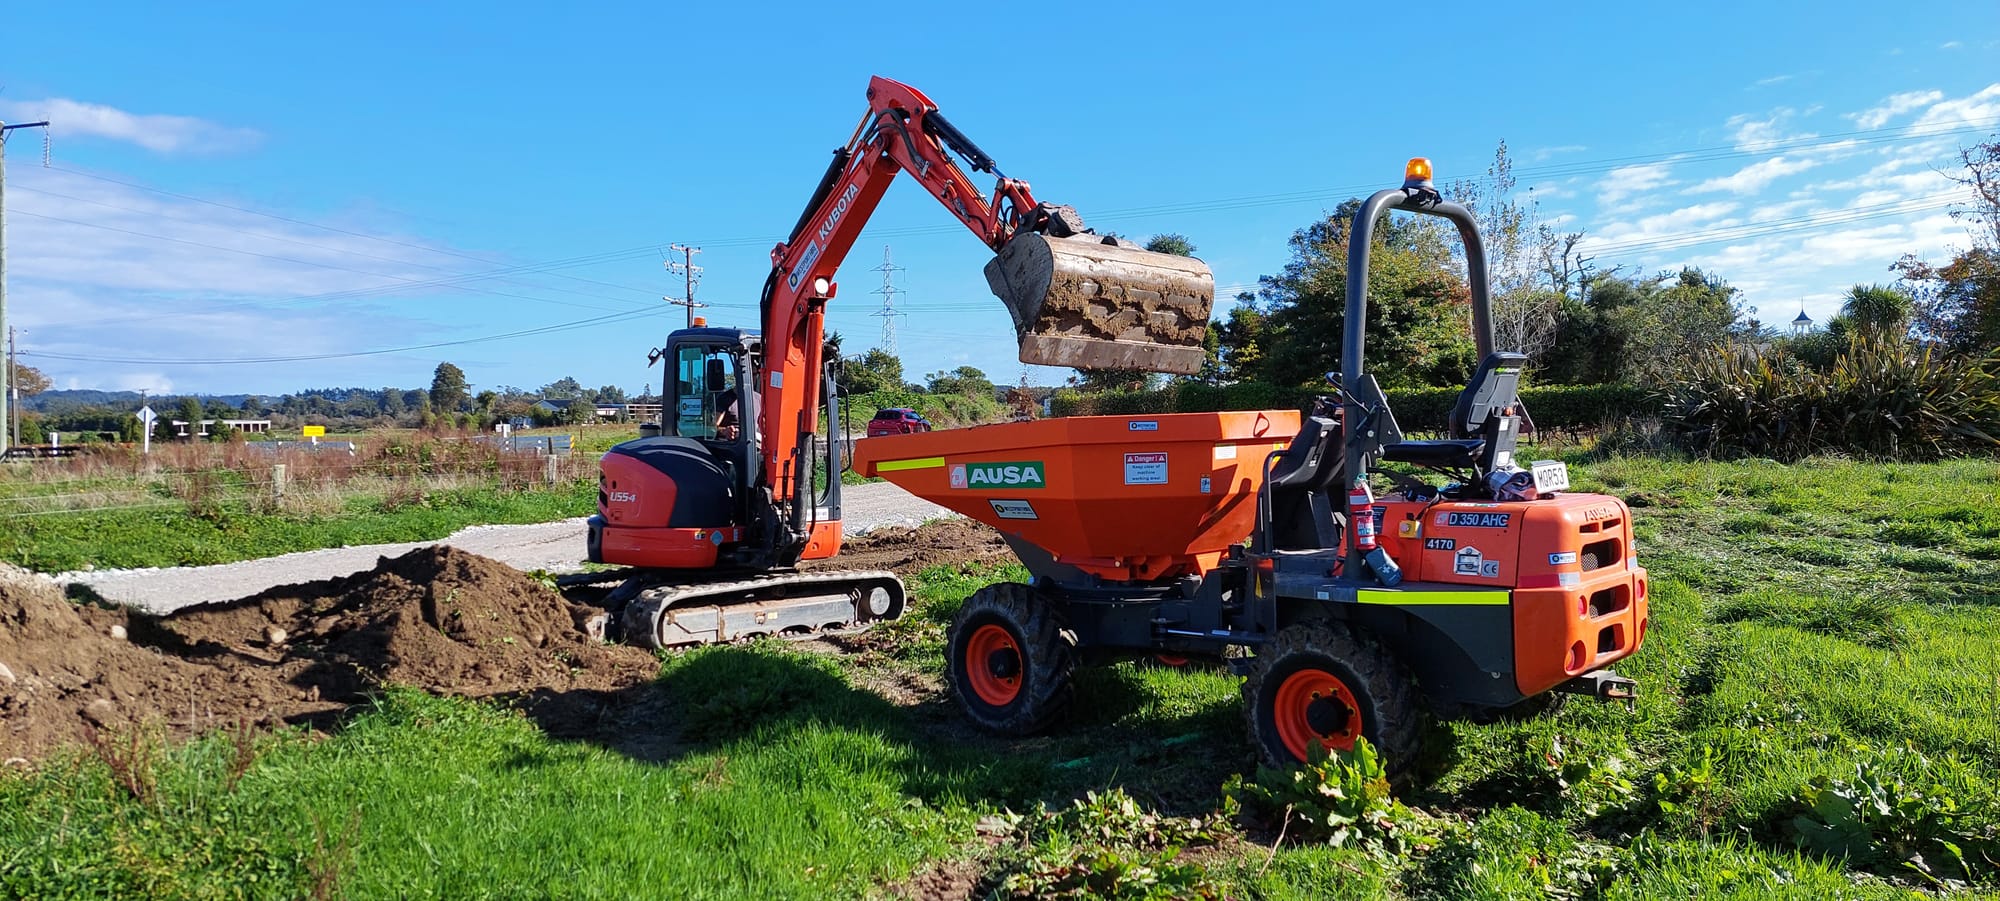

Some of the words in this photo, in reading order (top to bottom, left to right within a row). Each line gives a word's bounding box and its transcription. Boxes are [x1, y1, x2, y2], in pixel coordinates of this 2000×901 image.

[818, 183, 859, 241] KUBOTA
[970, 466, 1042, 484] AUSA
[1537, 467, 1565, 488] MQR53
[1449, 513, 1458, 525] D
[1460, 513, 1479, 526] 350
[1427, 539, 1453, 549] 4170
